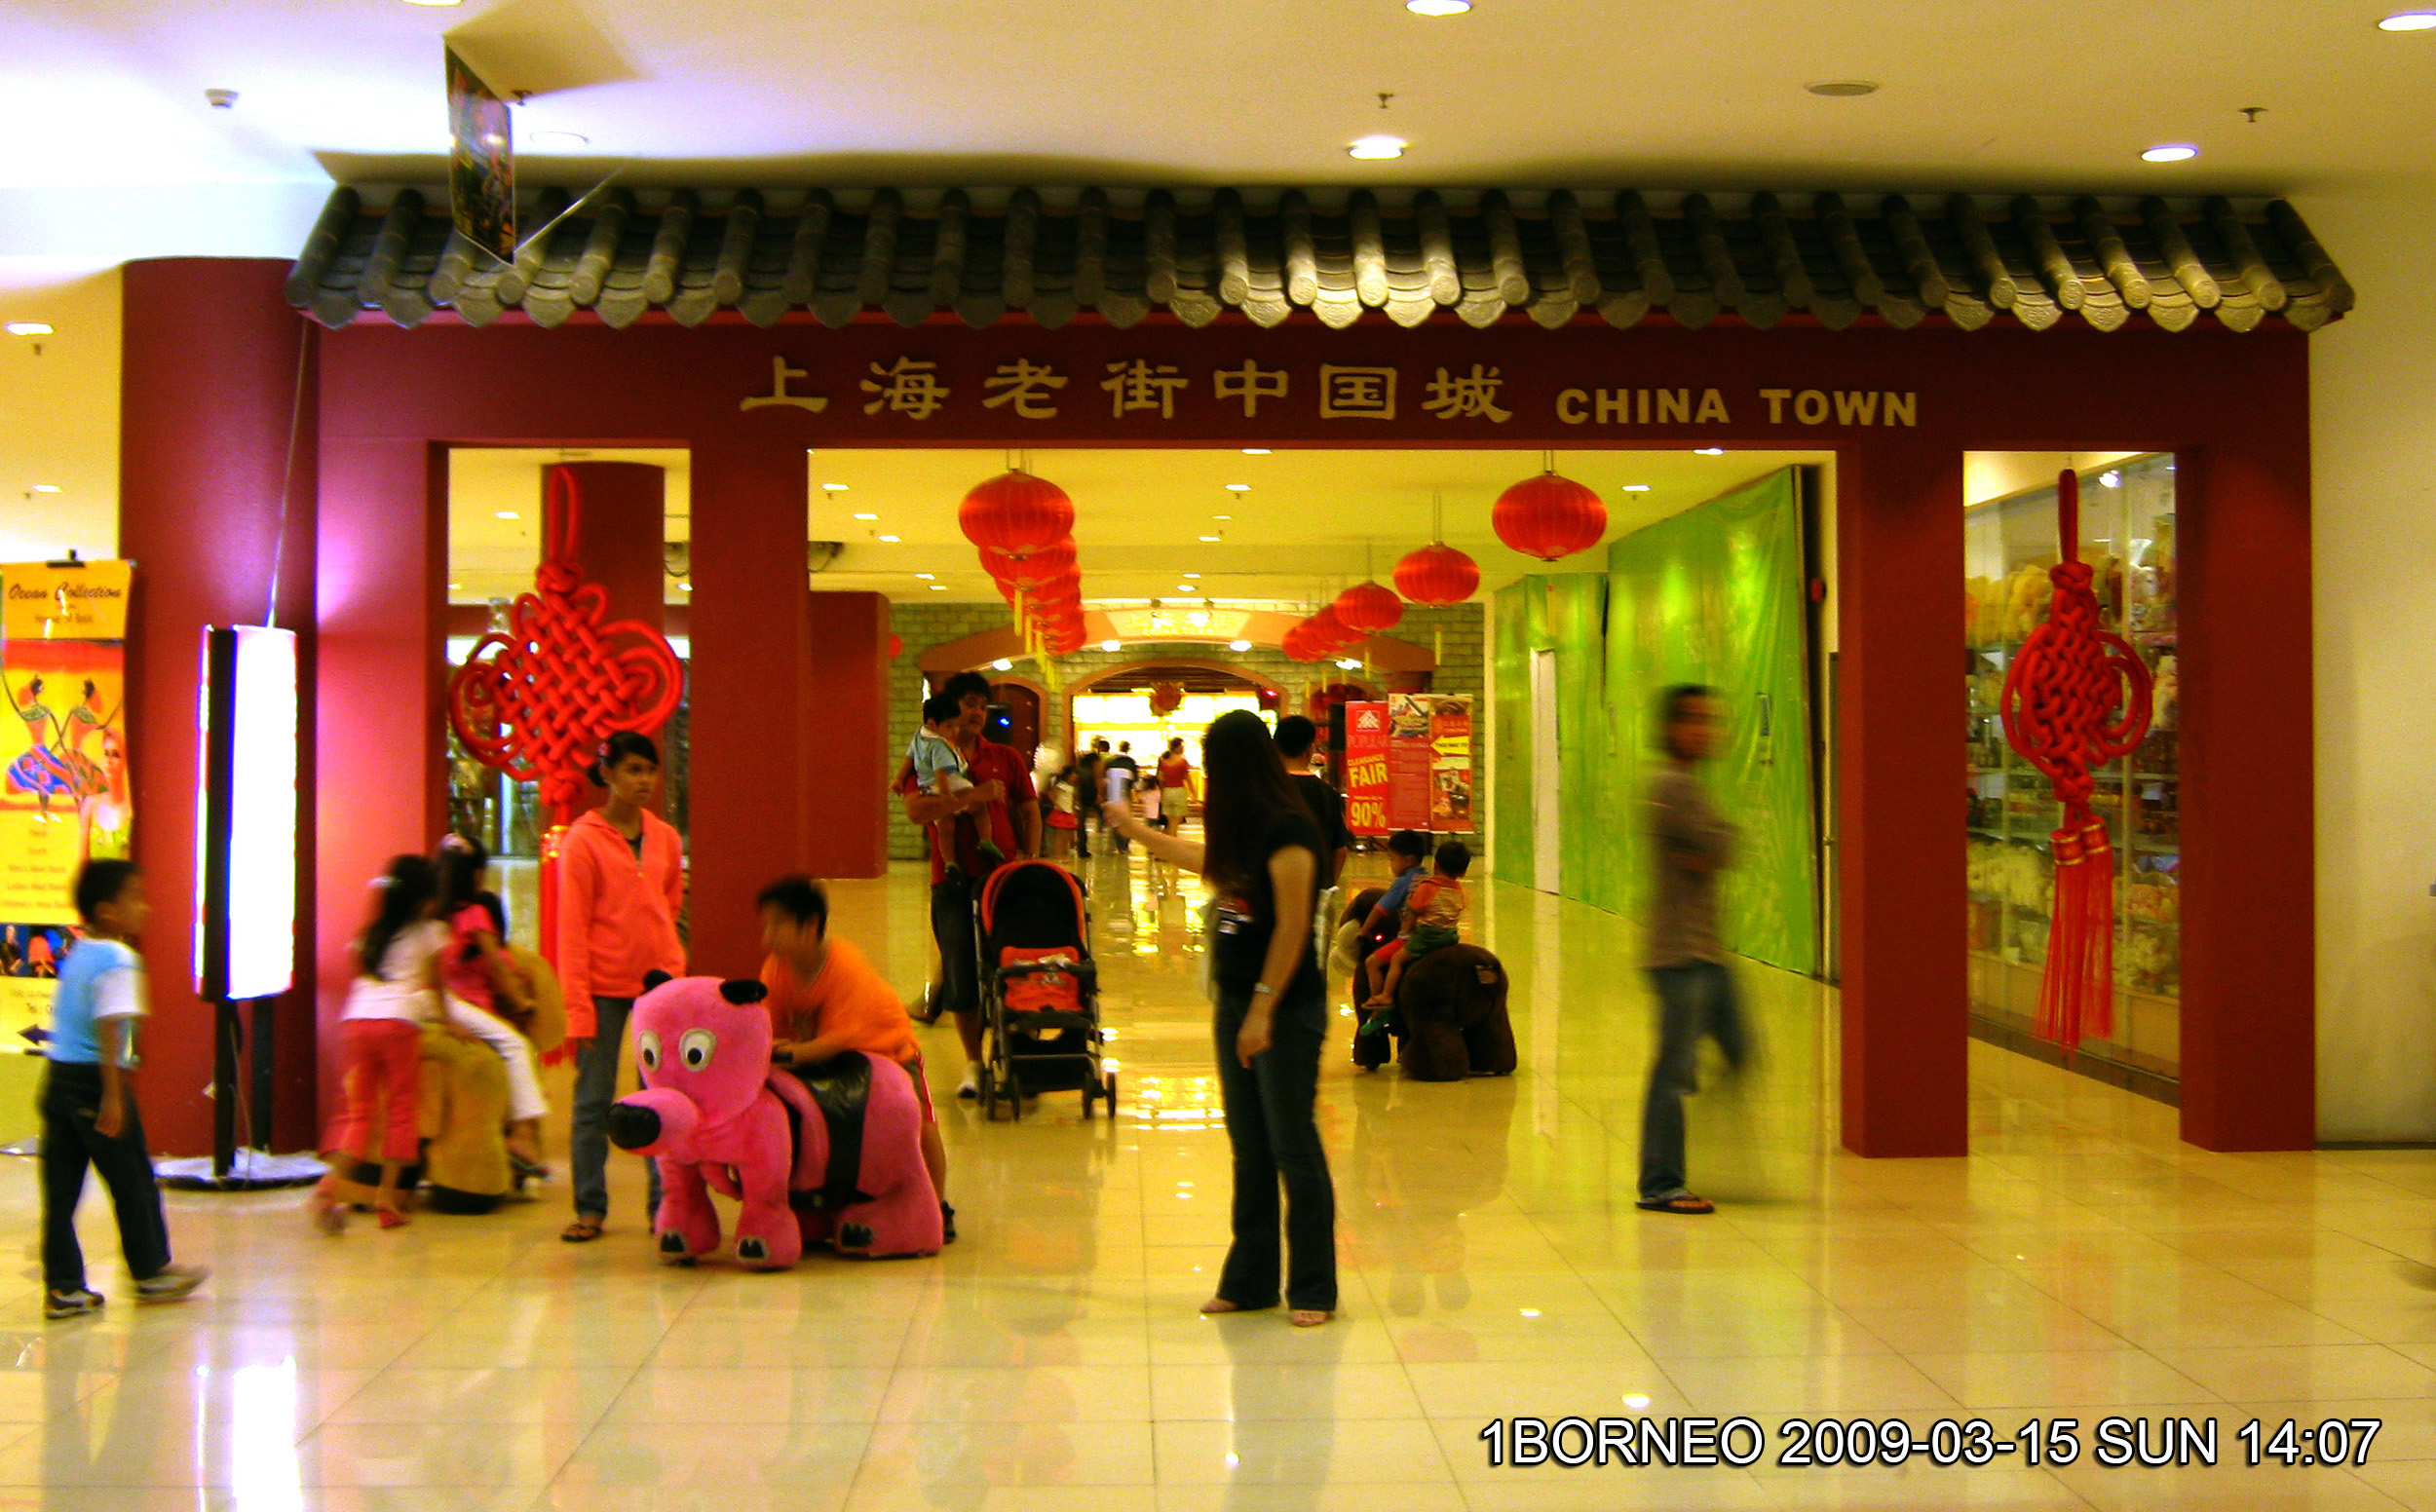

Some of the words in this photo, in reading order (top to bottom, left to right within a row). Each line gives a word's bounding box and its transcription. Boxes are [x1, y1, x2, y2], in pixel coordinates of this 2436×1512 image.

[739, 355, 1513, 424] 上海老街中国城
[1556, 388, 1732, 425] CHINA
[1759, 388, 1918, 427] TOWN
[8, 583, 48, 600] Ocean
[1348, 762, 1389, 788] FAIR
[1350, 801, 1387, 828] 90%
